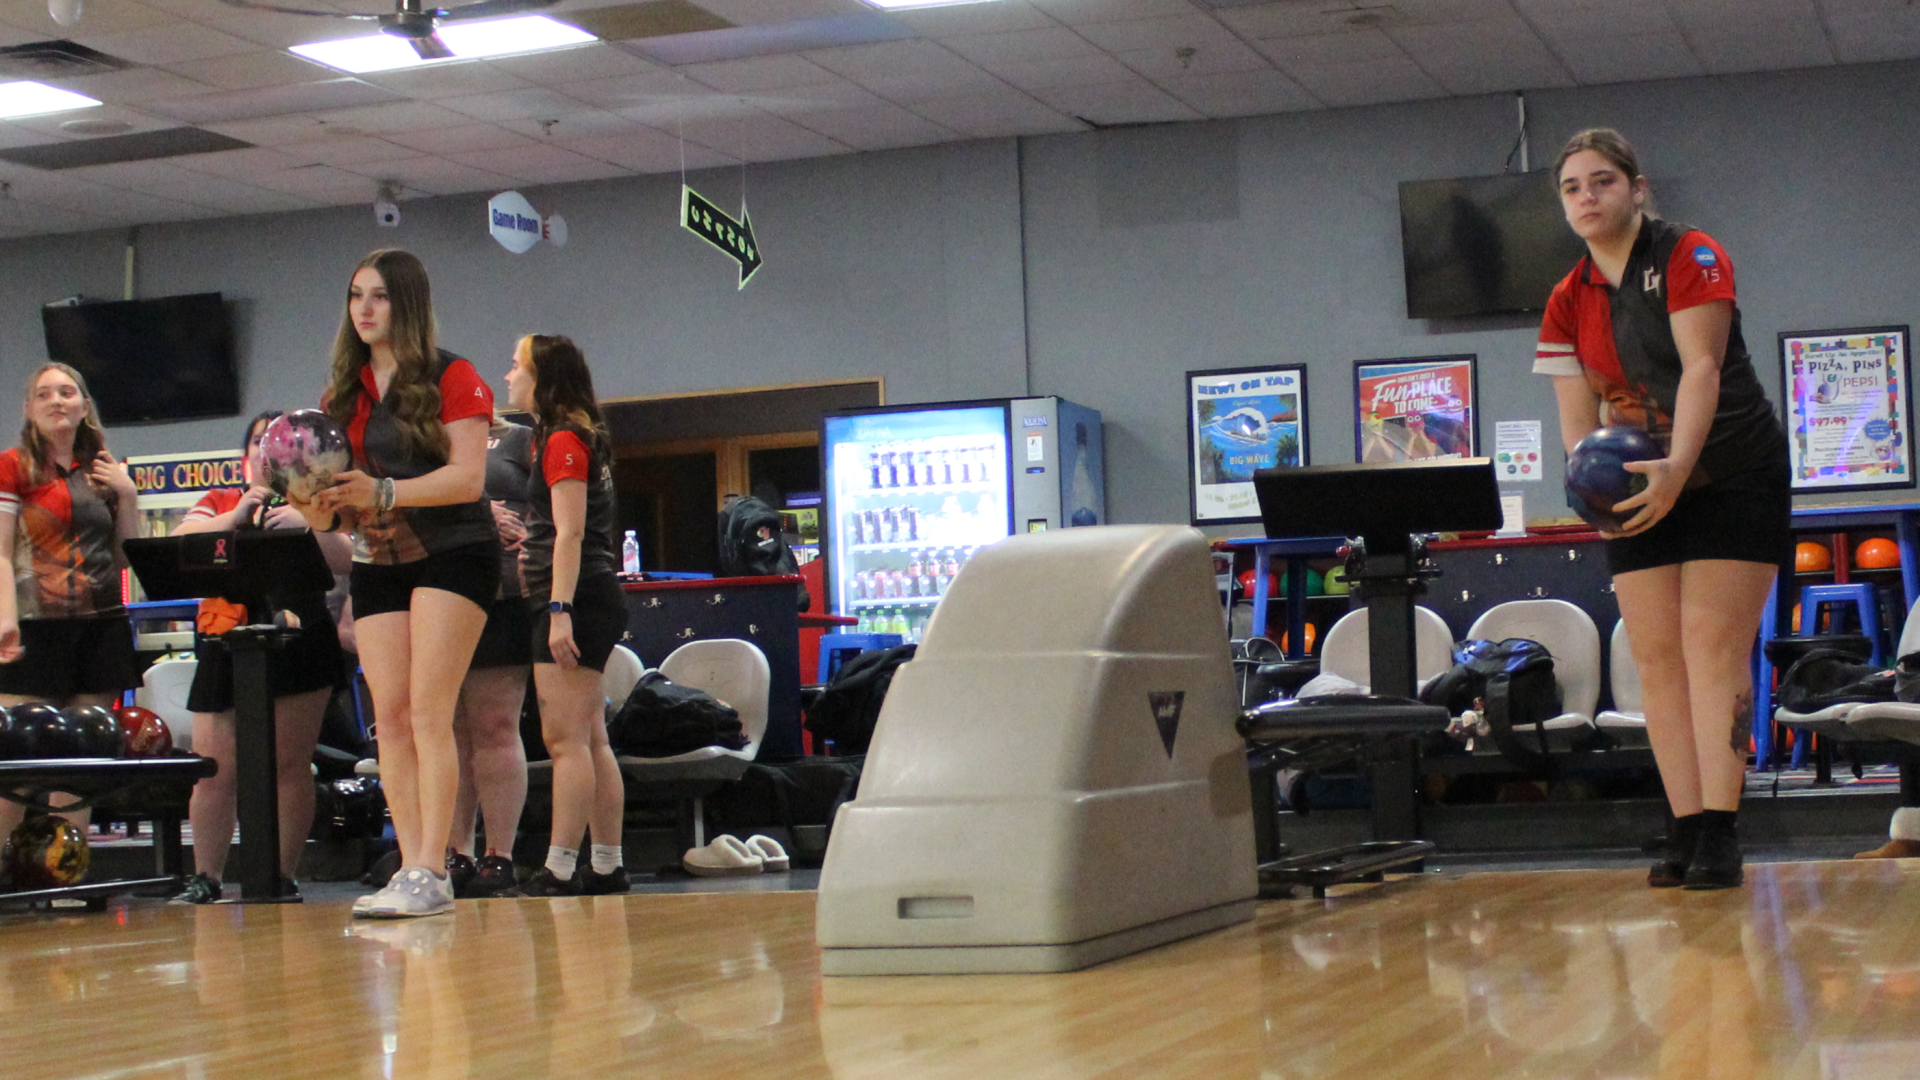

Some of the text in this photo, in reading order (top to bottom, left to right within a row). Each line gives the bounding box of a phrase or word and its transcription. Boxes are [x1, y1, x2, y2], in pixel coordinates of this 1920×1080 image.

[493, 208, 539, 234] Game Room
[1701, 268, 1720, 284] 15
[1853, 359, 1882, 373] PINS
[1240, 378, 1261, 390] ON
[1265, 376, 1294, 387] TAP
[1843, 376, 1878, 387] PEPSI
[474, 387, 483, 399] 4
[1372, 376, 1452, 412] Fun PLACE
[1394, 401, 1406, 414] TO
[1809, 416, 1847, 426] $97.99
[565, 453, 573, 466] 5
[1229, 454, 1270, 465] BIG WAVE
[134, 461, 243, 490] BIG CHOICE
